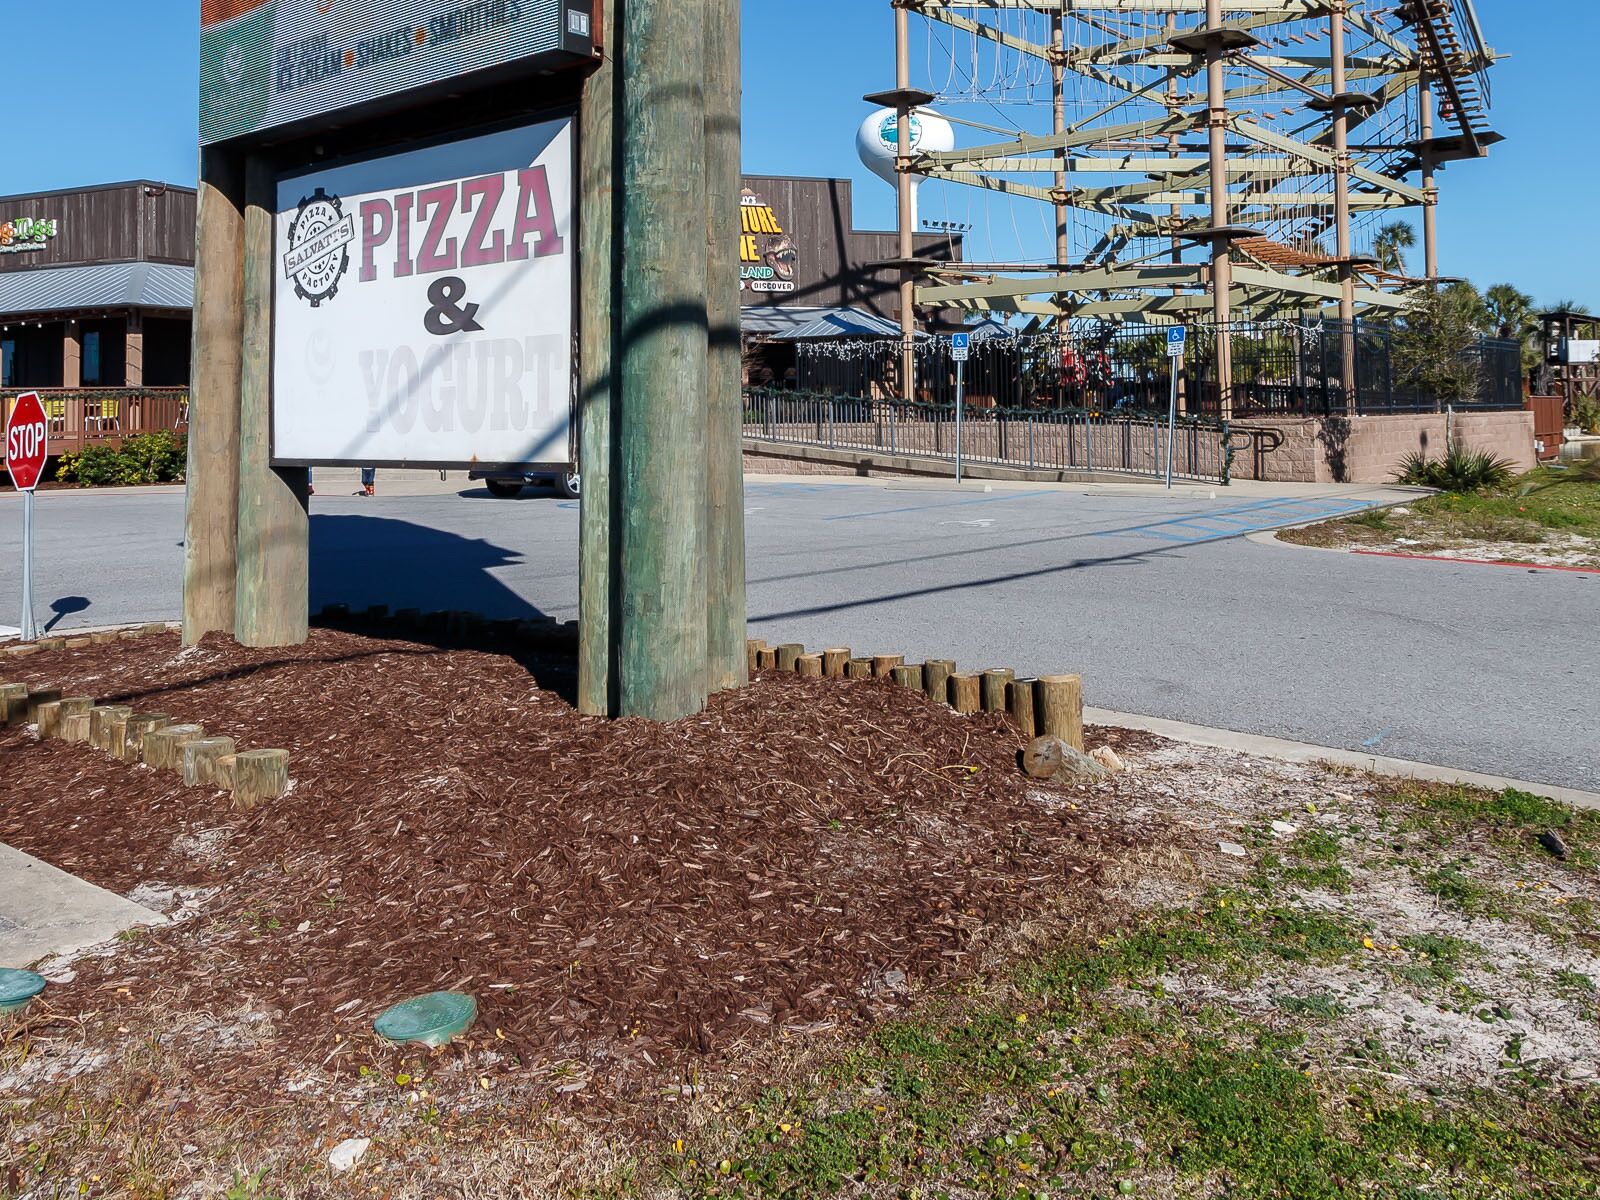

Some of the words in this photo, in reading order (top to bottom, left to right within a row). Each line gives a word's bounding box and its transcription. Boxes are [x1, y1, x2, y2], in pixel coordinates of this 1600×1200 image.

[356, 26, 413, 69] SHAKES
[276, 63, 294, 93] ICE
[296, 47, 342, 87] CREAM
[300, 207, 326, 230] PIZZA
[358, 164, 564, 282] PIZZA
[740, 207, 782, 233] TURE
[302, 253, 338, 288] FACTORY
[740, 267, 773, 279] LAND
[754, 282, 792, 290] DISCOVER
[424, 276, 484, 335] &
[358, 334, 563, 434] YOGURT
[10, 422, 44, 460] STOP
